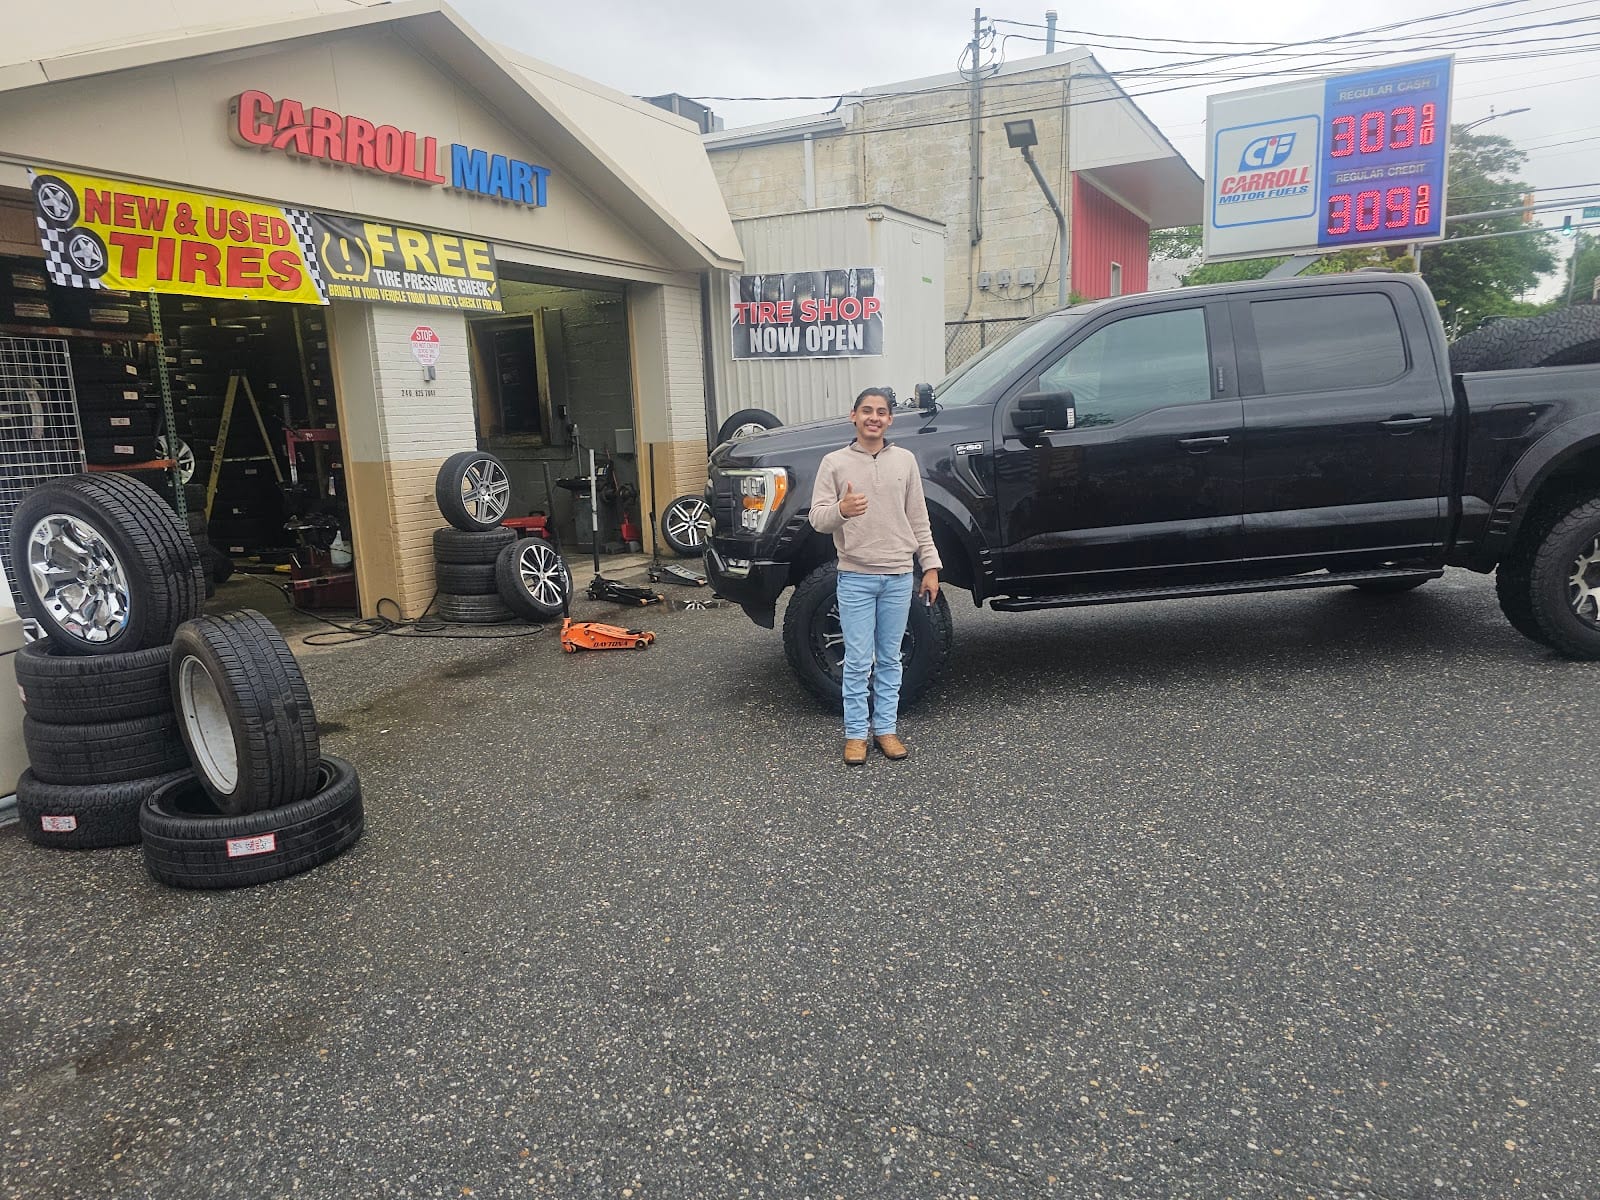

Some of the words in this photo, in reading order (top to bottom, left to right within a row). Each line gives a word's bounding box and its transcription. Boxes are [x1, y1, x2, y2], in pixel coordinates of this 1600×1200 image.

[1340, 84, 1393, 101] REGULAR
[1397, 78, 1431, 92] CASH
[1331, 106, 1415, 157] 303
[238, 90, 445, 184] CARROLL
[451, 143, 551, 207] MART
[1221, 166, 1310, 195] CARROLL
[1335, 169, 1384, 183] REGULAR
[1387, 163, 1426, 177] CREDIT
[1219, 191, 1265, 204] MOTOR
[1268, 185, 1308, 198] FUELS
[84, 187, 169, 231] NEW
[174, 202, 199, 236] &
[206, 206, 291, 246] USED
[1328, 186, 1411, 235] 309
[109, 231, 303, 291] TIRES
[363, 223, 495, 281] FREE
[328, 284, 352, 297] BRING
[352, 286, 361, 298] IN
[361, 287, 380, 300] YOUR
[380, 289, 407, 303] VEHICLE
[407, 292, 426, 304] TODAY
[427, 293, 440, 305] AND
[458, 296, 476, 308] CHECK
[373, 269, 402, 288] TIRE
[403, 272, 458, 293] PRESSURE
[457, 279, 490, 297] CHECK
[734, 300, 794, 325] TIRE
[800, 297, 881, 322] SHOP
[415, 330, 433, 340] STOP
[749, 326, 800, 353] NOW
[805, 324, 864, 351] OPEN
